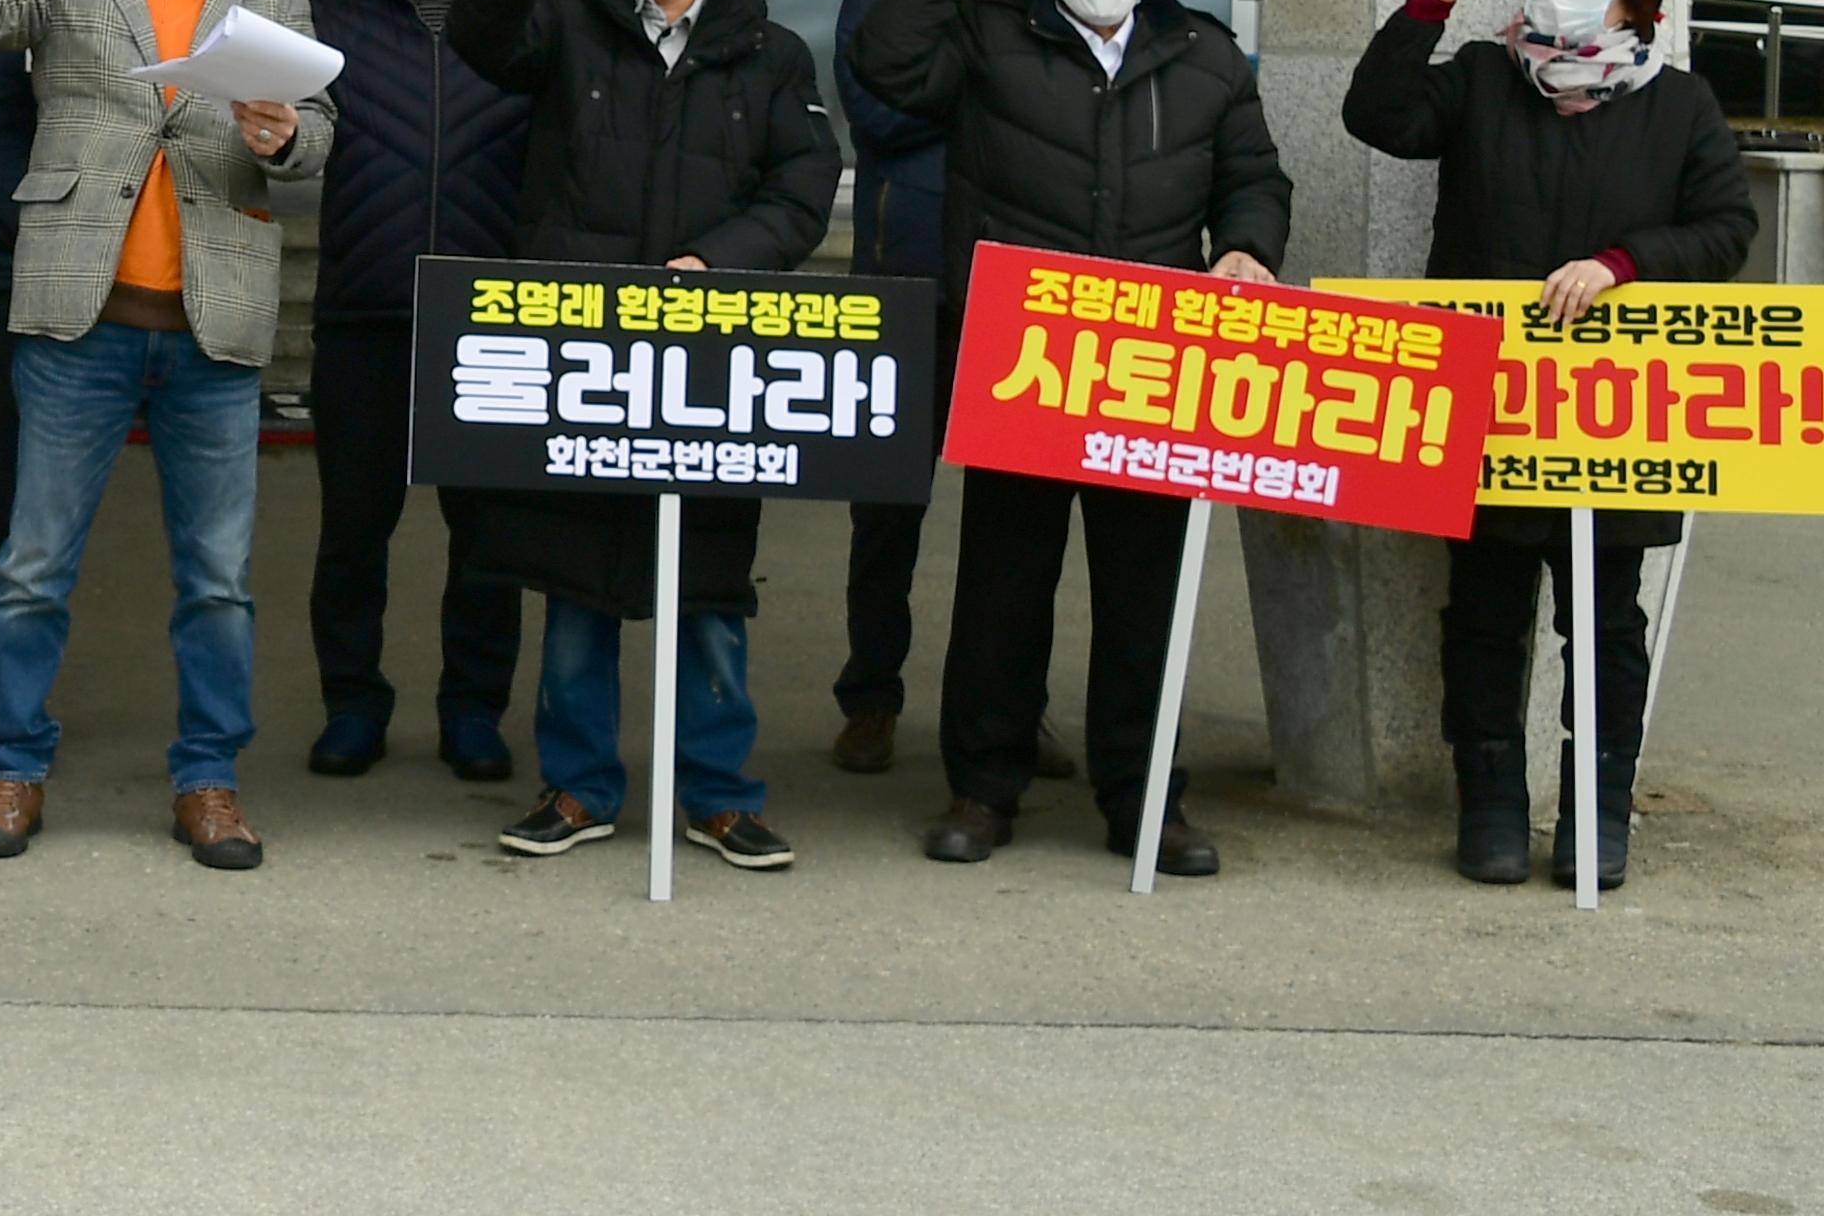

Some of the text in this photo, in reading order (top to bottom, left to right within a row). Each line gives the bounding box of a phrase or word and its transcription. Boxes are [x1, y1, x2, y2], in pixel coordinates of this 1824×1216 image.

[470, 279, 882, 341] 조명래 환경부장관은
[1022, 267, 1162, 329] 조명래
[1171, 287, 1444, 371] 환경부장관은
[451, 333, 898, 438] 물러나라!
[991, 324, 1454, 468] 사퇴하라!
[545, 433, 800, 486] 화천군번영회
[1080, 430, 1340, 508] 화천군번영회
